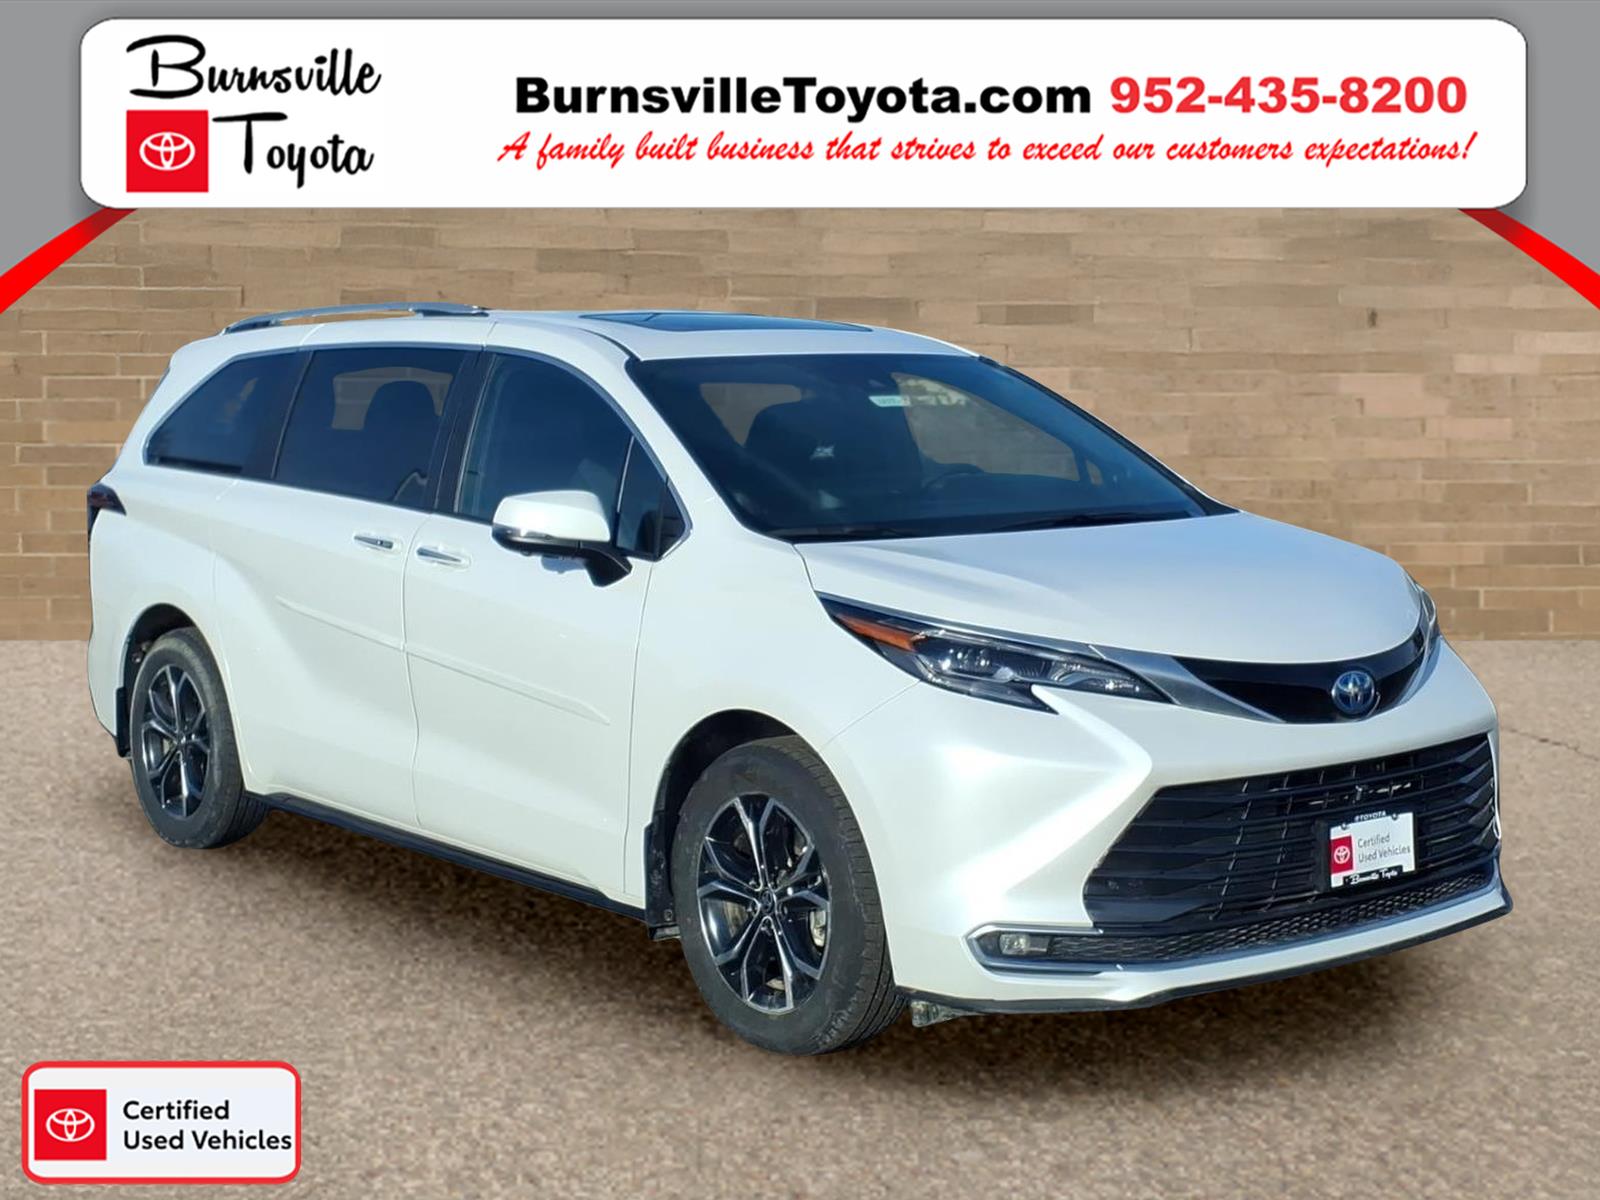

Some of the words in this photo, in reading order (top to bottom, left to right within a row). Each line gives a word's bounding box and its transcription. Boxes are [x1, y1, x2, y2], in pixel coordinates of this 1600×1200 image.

[1359, 810, 1386, 821] TOYOTA
[1357, 832, 1391, 849] Certified
[1358, 850, 1378, 863] Used
[1379, 844, 1411, 859] Vehicles
